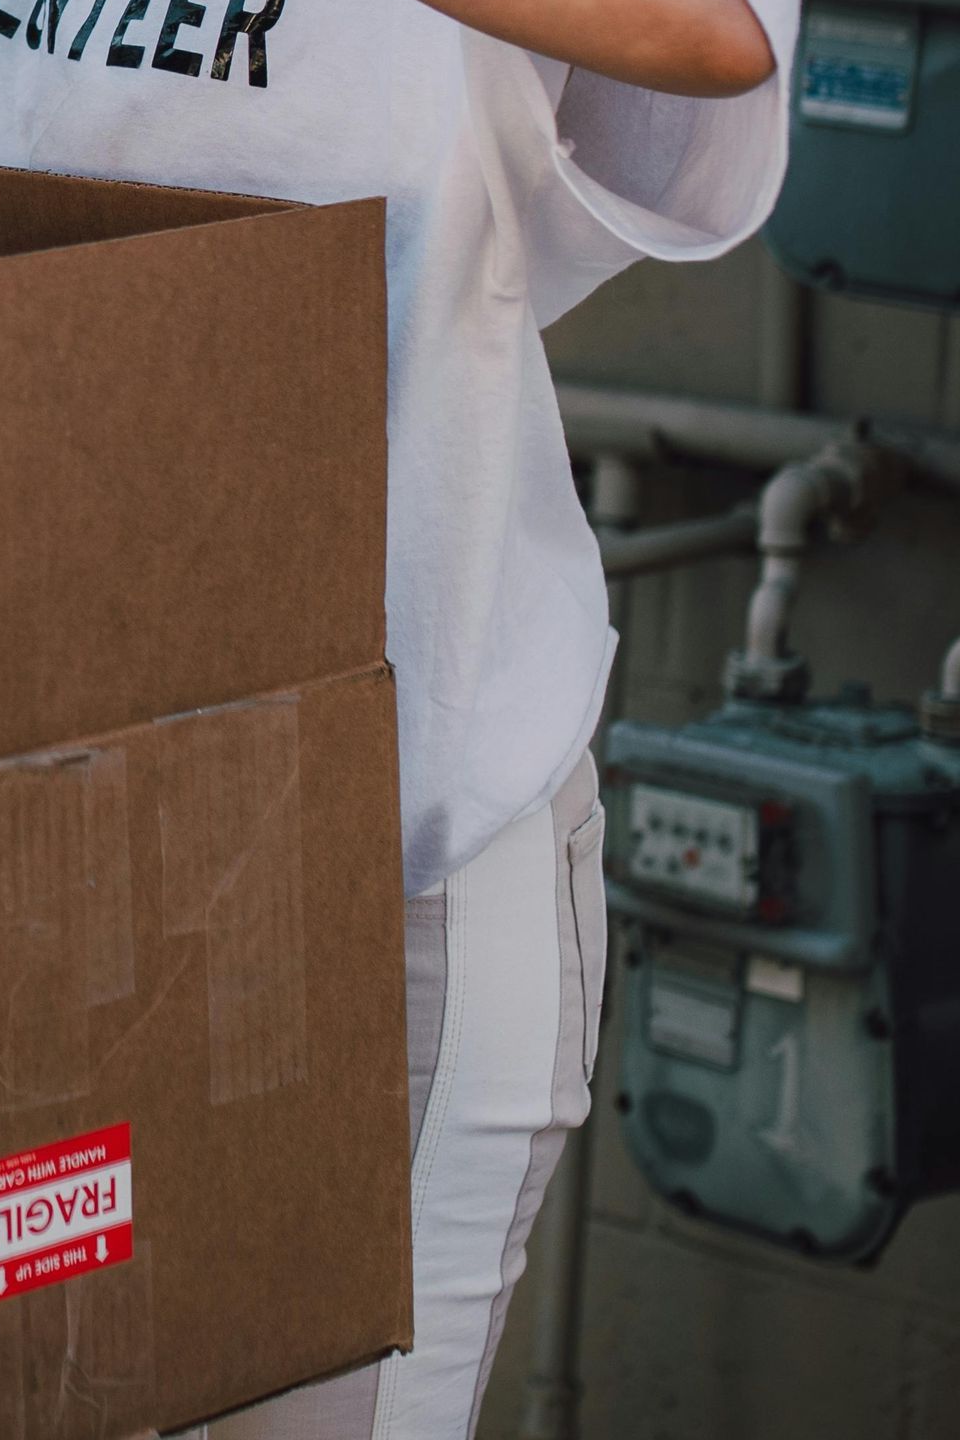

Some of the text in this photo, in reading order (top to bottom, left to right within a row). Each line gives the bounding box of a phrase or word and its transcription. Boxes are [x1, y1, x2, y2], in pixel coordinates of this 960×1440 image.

[27, 1160, 56, 1182] WITH
[58, 1144, 107, 1173] HANDLE
[15, 1246, 88, 1283] THIS SIDE UP
